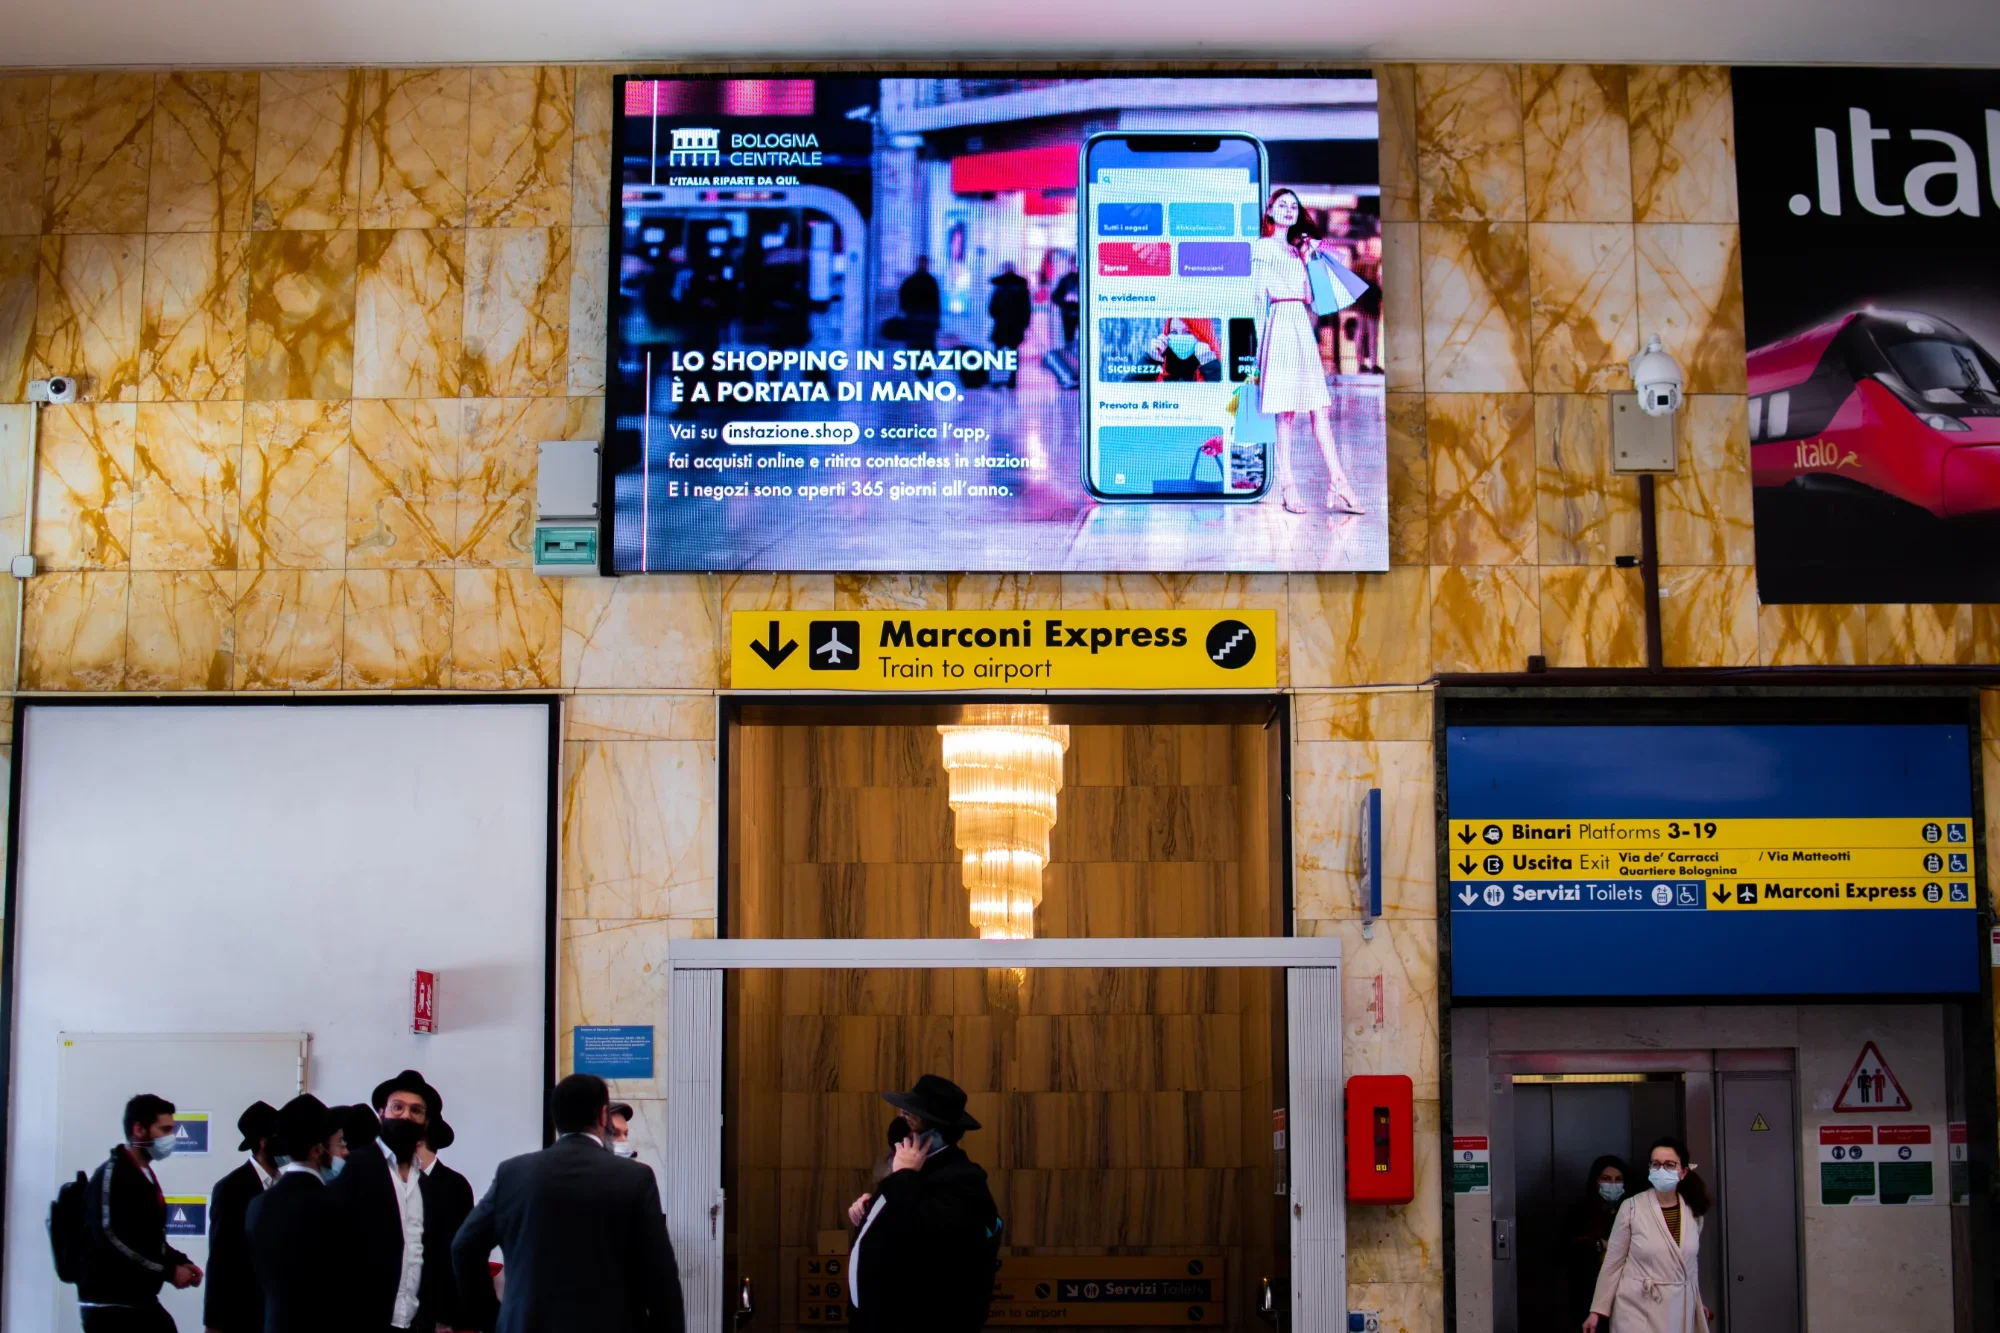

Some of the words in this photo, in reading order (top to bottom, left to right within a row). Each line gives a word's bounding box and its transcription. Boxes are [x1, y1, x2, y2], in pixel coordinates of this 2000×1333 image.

[731, 133, 819, 148] BOLOGNA
[730, 151, 823, 166] CENTRALE
[669, 176, 711, 186] L'ITALIA
[713, 176, 755, 186] RIPARTE
[757, 176, 773, 186] DA
[775, 176, 800, 186] QUI.
[1098, 294, 1108, 302] In
[1110, 294, 1156, 302] evidenza
[672, 351, 705, 371] LO
[711, 350, 848, 371] SHOPPING
[856, 350, 885, 371] IN
[892, 349, 1017, 371] STAZIONE
[1107, 365, 1164, 374] SICUREZZA
[671, 377, 684, 402] È
[691, 382, 711, 402] A
[718, 382, 830, 402] PORTATA
[838, 382, 863, 402] DI
[871, 381, 964, 402] MANO.
[1099, 401, 1139, 409] Prenota
[1141, 401, 1149, 409] &
[1152, 401, 1179, 409] Ritira
[669, 424, 696, 440] Vai
[701, 427, 718, 440] su
[728, 424, 853, 442] instazione.shop
[864, 427, 875, 440] o
[880, 423, 938, 440] scarica
[942, 422, 991, 443] l'app,
[668, 452, 689, 469] fai
[693, 453, 752, 473] acquisti
[757, 453, 804, 469] online
[809, 457, 819, 469] e
[824, 452, 861, 469] ritira
[866, 452, 951, 469] contactless
[954, 452, 969, 469] in
[669, 482, 679, 497] E
[683, 482, 689, 497] i
[693, 482, 749, 501] negozi
[753, 485, 792, 498] sono
[797, 482, 846, 501] aperti
[851, 481, 884, 497] 365
[888, 481, 938, 501] giorni
[942, 480, 1014, 497] all'anno.
[879, 620, 1031, 648] Marconi
[1045, 621, 1188, 654] Express
[879, 656, 933, 678] Train
[942, 659, 966, 678] to
[973, 658, 1053, 684] airport
[1512, 824, 1572, 840] Binari
[1579, 823, 1661, 840] Platforms
[1668, 822, 1717, 838] 3-19
[1512, 854, 1573, 870] Uscita
[1580, 854, 1610, 870] Exit
[1619, 852, 1641, 863] Via
[1644, 852, 1664, 862] de'
[1668, 852, 1719, 862] Carracci
[1767, 851, 1789, 862] Via
[1792, 851, 1851, 862] Matteotti
[1619, 866, 1676, 876] Quartiere
[1679, 866, 1737, 876] Bolognina
[1512, 884, 1580, 900] Servizi
[1586, 884, 1642, 900] Toilets
[1764, 883, 1840, 899] Marconi
[1845, 882, 1917, 901] Express
[1105, 1282, 1157, 1295] Servizi
[1010, 1308, 1021, 1318] to
[1025, 1307, 1068, 1321] airport
